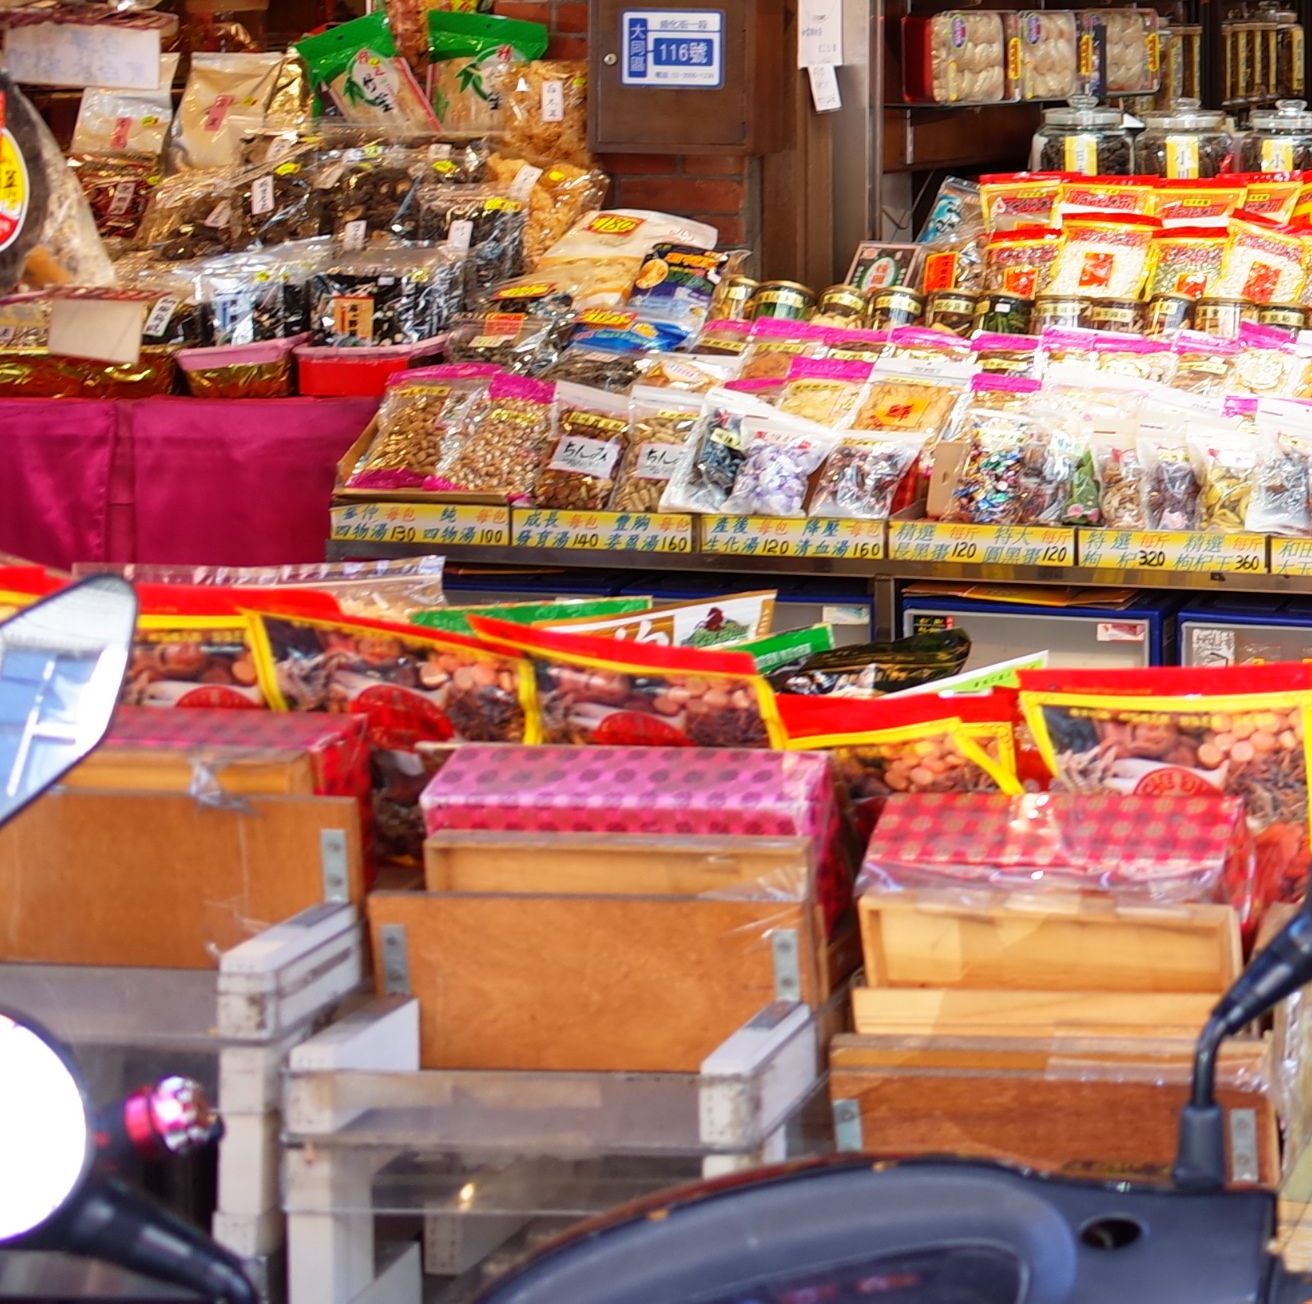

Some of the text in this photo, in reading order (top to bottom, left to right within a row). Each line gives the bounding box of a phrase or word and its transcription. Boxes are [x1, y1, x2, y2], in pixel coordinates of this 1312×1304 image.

[630, 23, 646, 72] 大同區
[659, 42, 708, 64] 116號
[522, 511, 560, 528] 成長
[711, 516, 749, 534] 產後
[480, 528, 503, 543] 100
[571, 533, 600, 547] 140
[661, 536, 688, 552] 160
[705, 535, 790, 555] 生化湯 120
[852, 542, 881, 557] 160
[951, 541, 978, 559] 120
[1042, 546, 1068, 563] 120
[1138, 550, 1166, 567] 320
[1233, 554, 1260, 571] 360
